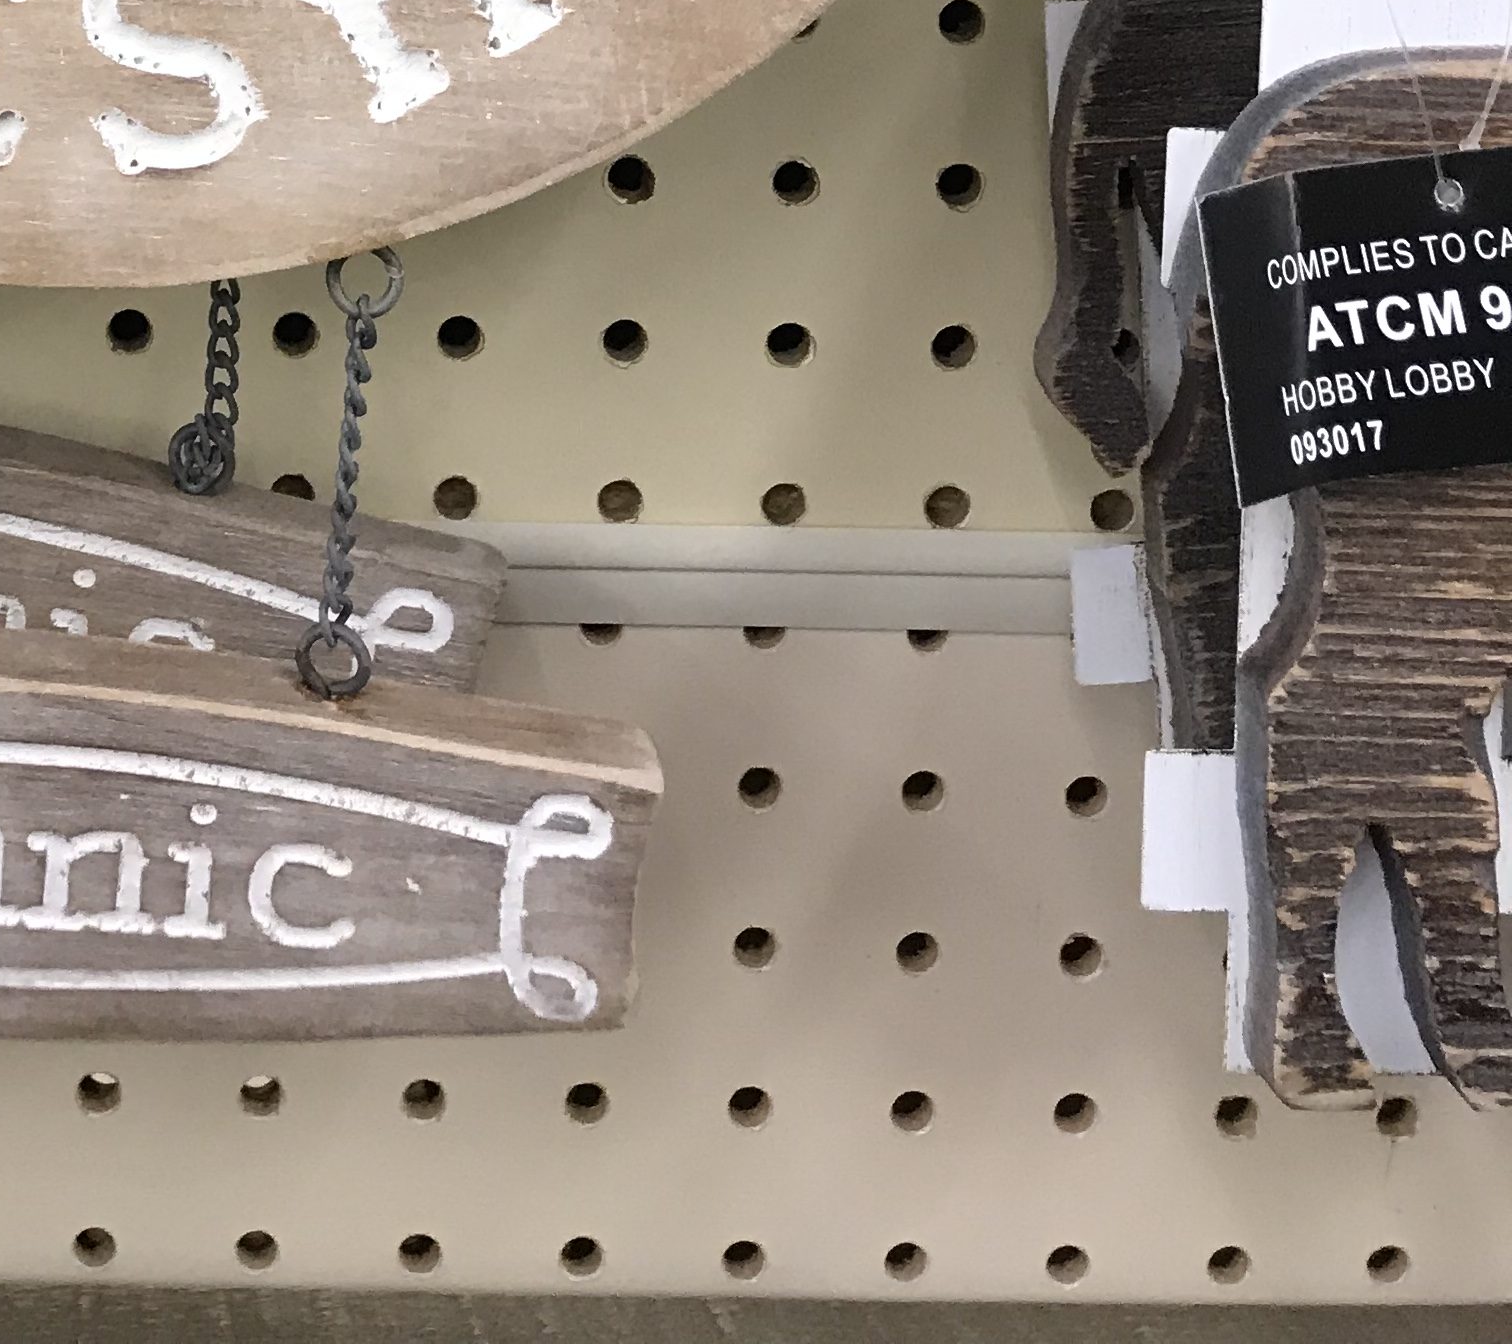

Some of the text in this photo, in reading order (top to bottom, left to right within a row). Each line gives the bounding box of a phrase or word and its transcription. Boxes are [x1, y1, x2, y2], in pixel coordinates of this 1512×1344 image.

[1267, 238, 1414, 289] COMPLIES
[1419, 232, 1466, 266] TO
[1307, 285, 1512, 352] ATCM 9
[1281, 357, 1494, 416] HOBBY LOBBY
[1290, 419, 1383, 465] 093017
